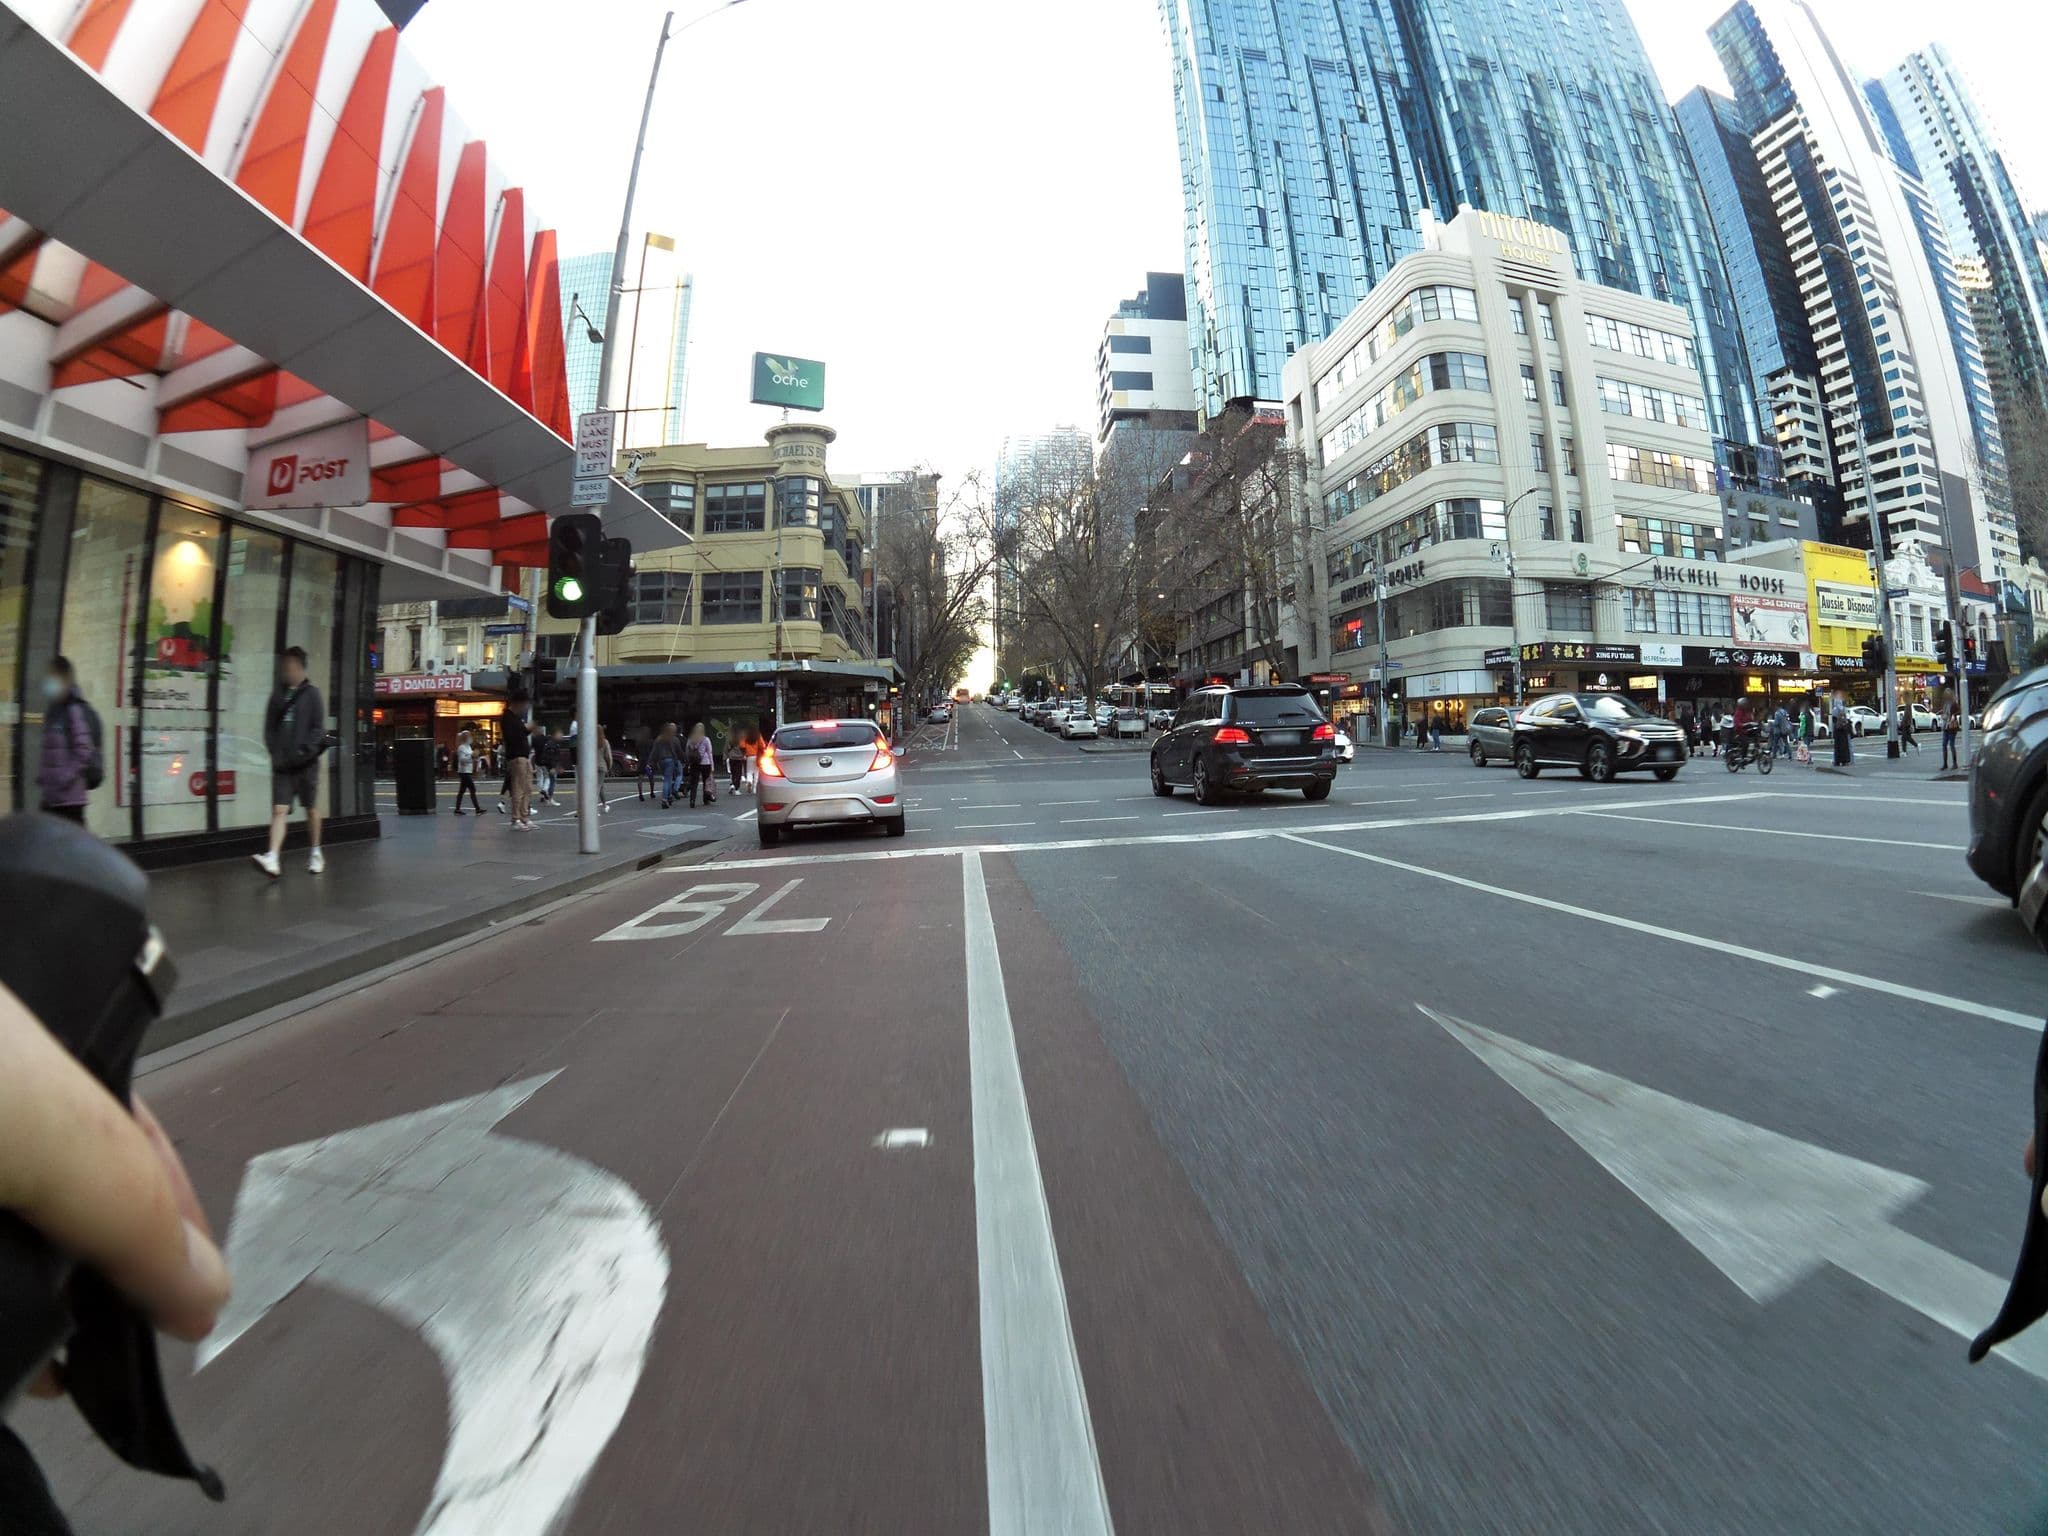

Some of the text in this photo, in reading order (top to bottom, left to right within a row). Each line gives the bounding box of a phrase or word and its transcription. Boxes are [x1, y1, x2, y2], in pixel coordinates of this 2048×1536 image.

[1501, 243, 1552, 266] HOUSE
[772, 374, 808, 388] oche
[584, 416, 609, 427] LEFT
[582, 427, 609, 438] LANE
[581, 439, 608, 450] MUST
[581, 451, 607, 461] TURN
[299, 459, 349, 484] POST
[580, 462, 605, 473] LEFT
[579, 482, 603, 491] BUSES
[1388, 560, 1425, 587] HOUSE
[1653, 564, 1785, 594] MITCHELL HOUSE
[1821, 595, 1844, 610] Aussie
[1595, 651, 1611, 660] XING
[1611, 652, 1619, 660] FU
[1834, 656, 1855, 667] Noodle
[404, 677, 463, 690] DANTA PETZ
